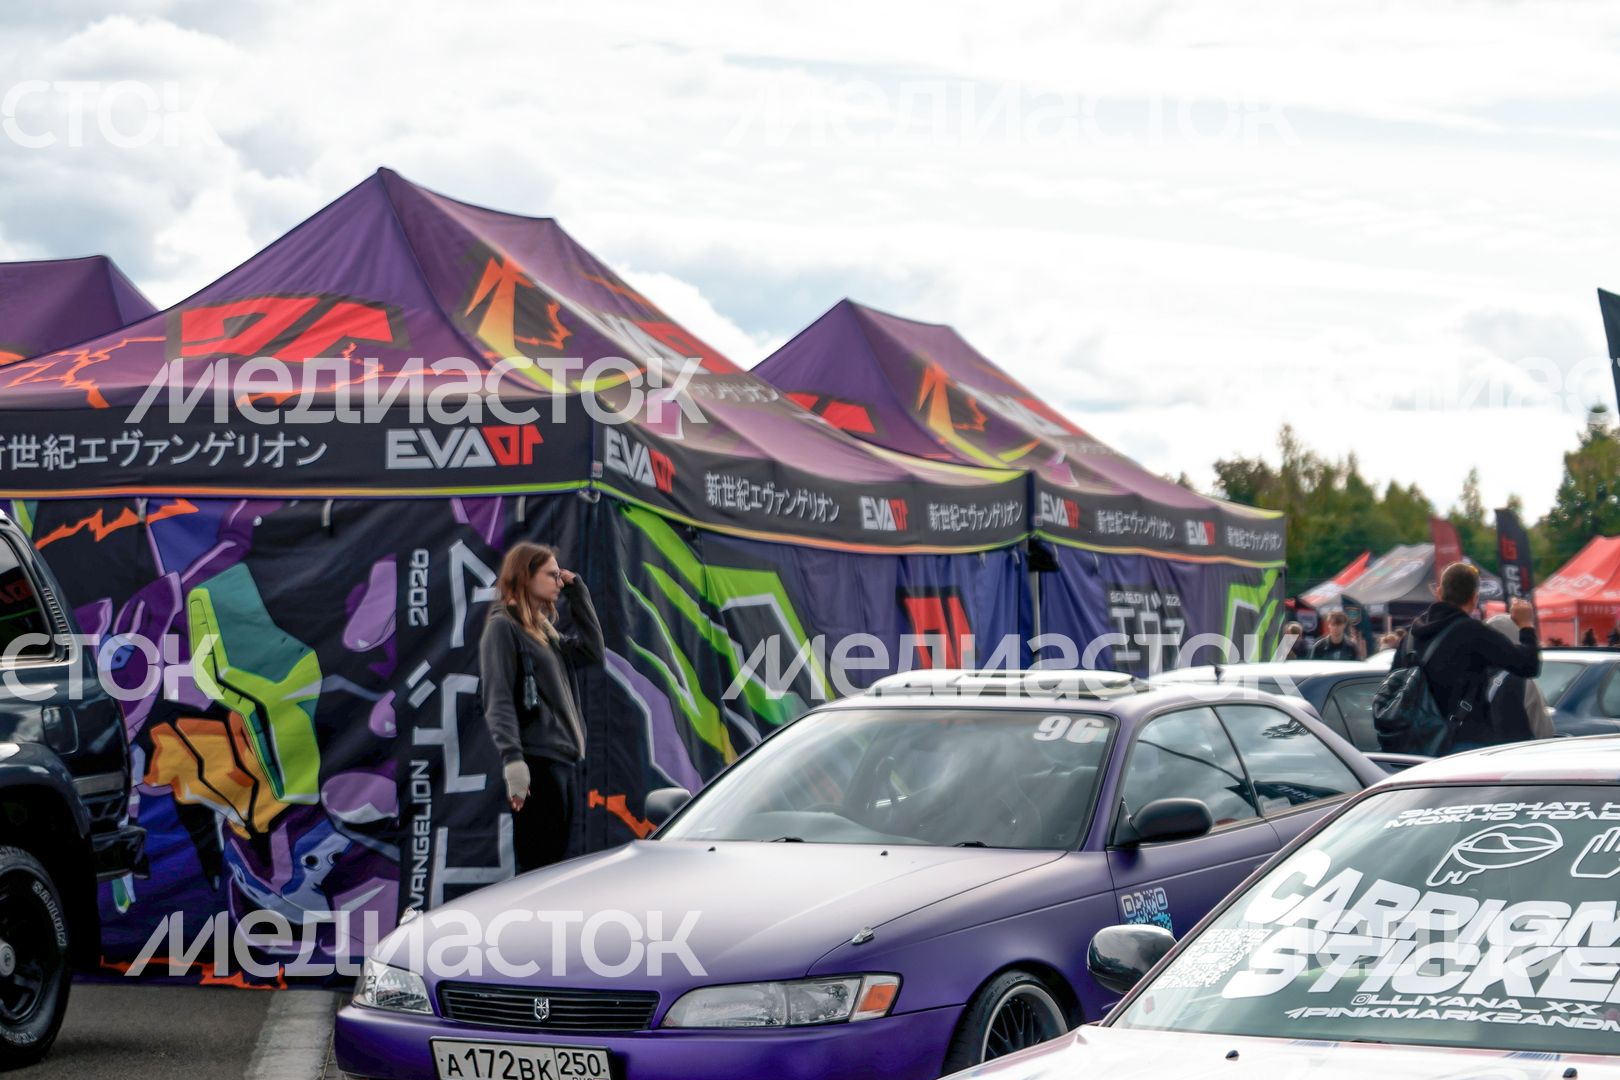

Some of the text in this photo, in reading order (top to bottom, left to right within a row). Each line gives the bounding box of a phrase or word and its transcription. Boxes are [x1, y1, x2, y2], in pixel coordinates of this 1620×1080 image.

[408, 548, 430, 626] 2026
[1032, 714, 1105, 743] 96
[1384, 811, 1517, 829] МОЖНО
[557, 1051, 601, 1077] 250
